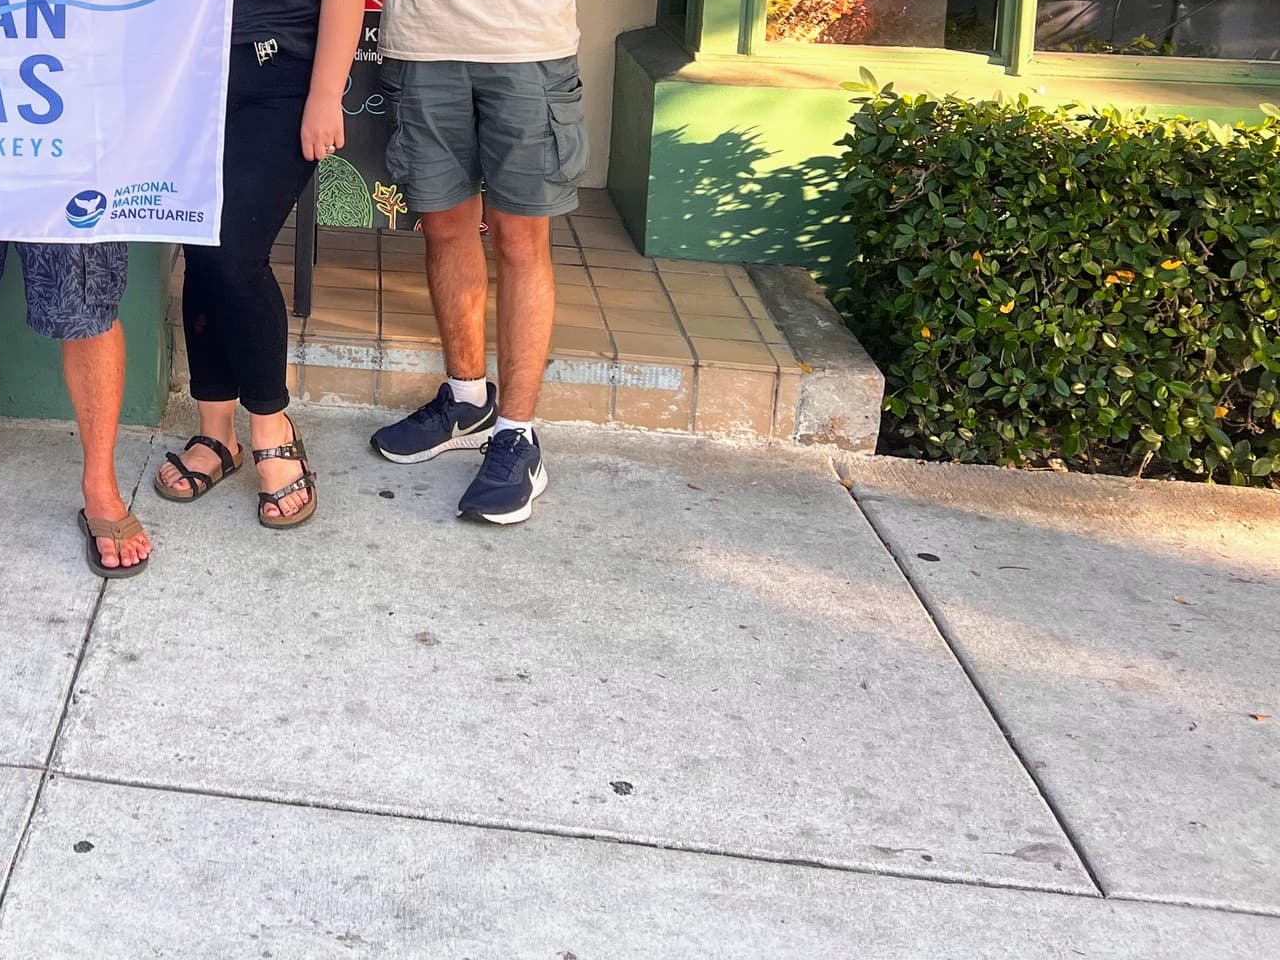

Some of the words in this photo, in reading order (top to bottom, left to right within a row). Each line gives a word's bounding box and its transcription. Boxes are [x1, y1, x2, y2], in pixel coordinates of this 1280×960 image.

[114, 181, 178, 198] NATIONAL
[112, 195, 162, 209] MARINE
[110, 207, 205, 223] SANCTUARIES
